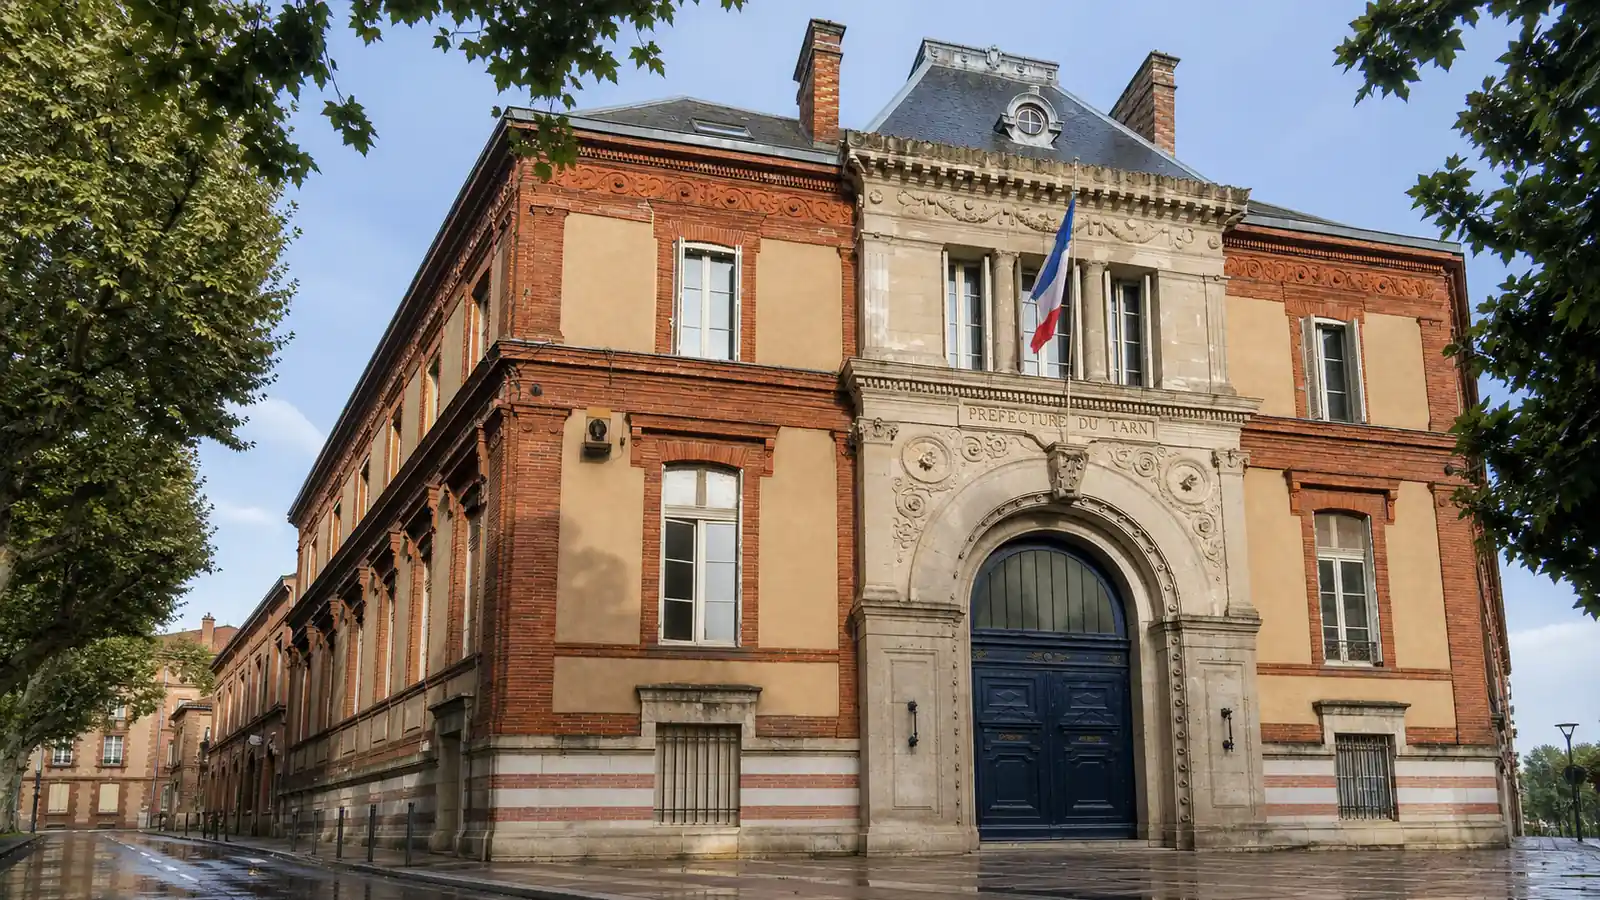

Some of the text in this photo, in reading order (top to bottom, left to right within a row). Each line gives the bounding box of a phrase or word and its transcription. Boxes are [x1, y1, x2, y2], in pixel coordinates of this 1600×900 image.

[968, 407, 1148, 435] PREFECTURE DU TARN
